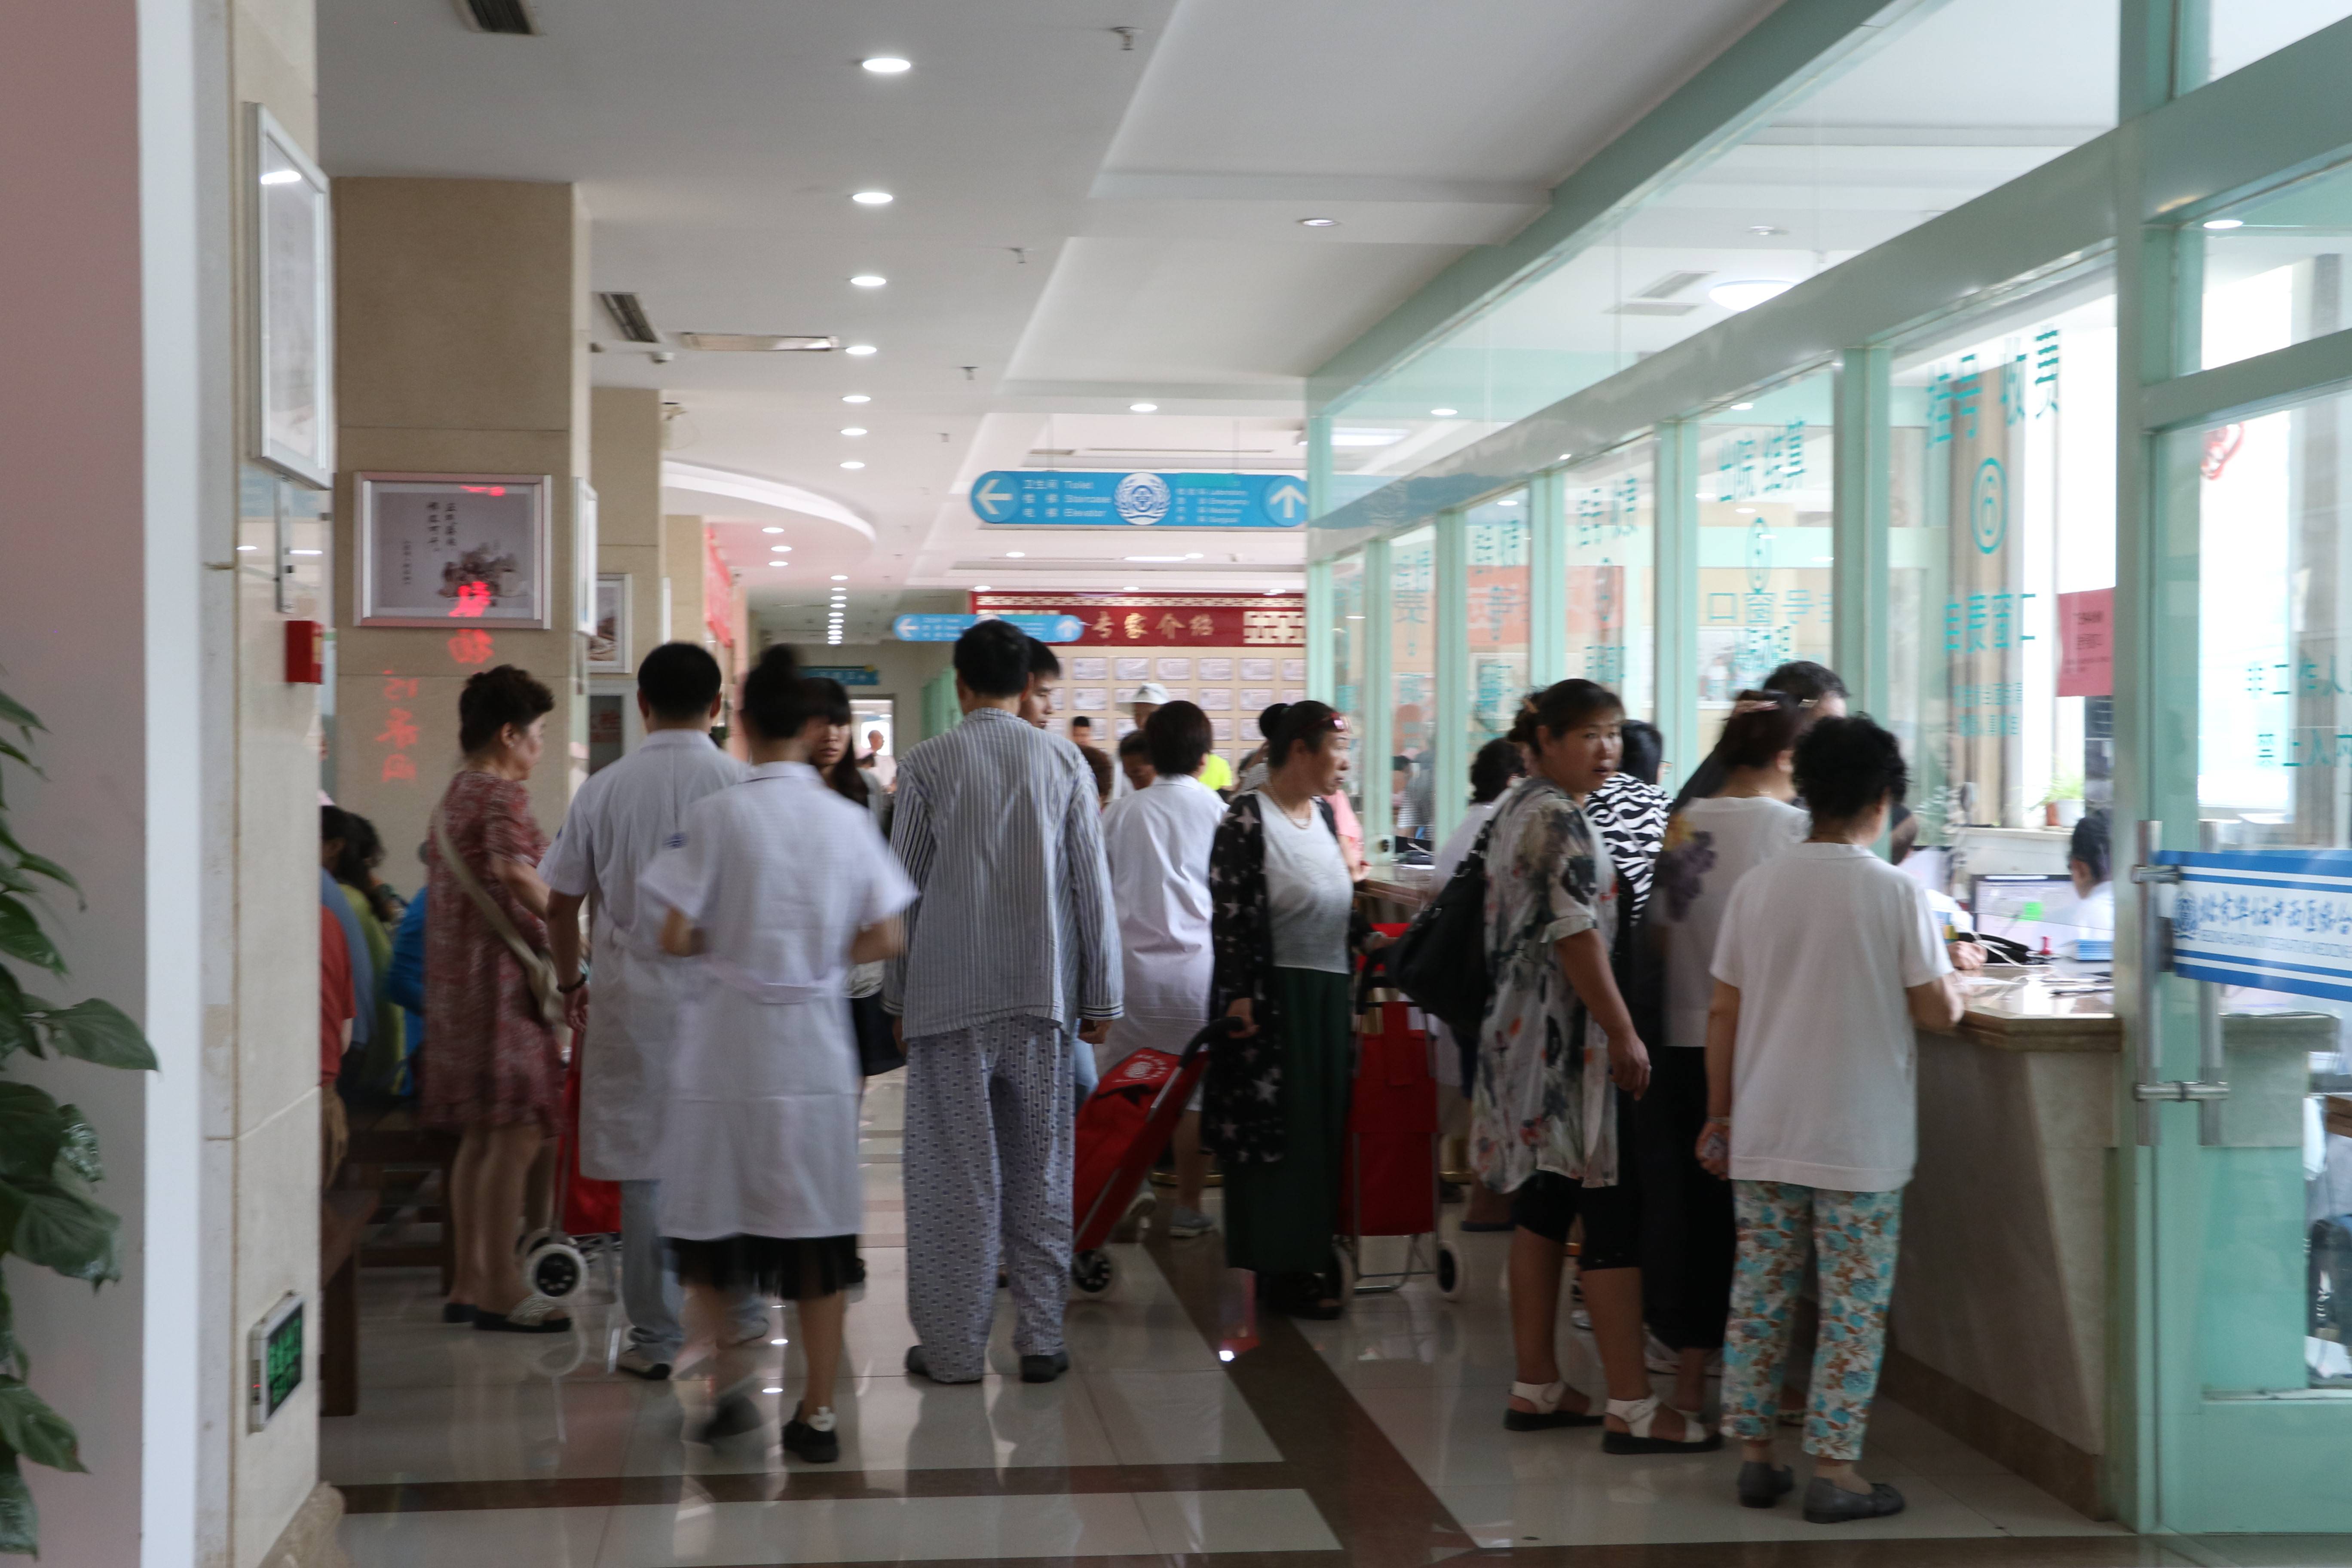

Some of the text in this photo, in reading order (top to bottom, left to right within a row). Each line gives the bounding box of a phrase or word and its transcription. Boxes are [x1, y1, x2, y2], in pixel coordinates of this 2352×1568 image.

[1063, 481, 1094, 489] Toilet
[1064, 494, 1112, 503] Staircase
[1064, 508, 1107, 517] Elevator
[1092, 611, 1215, 640] 专家介绍
[2245, 652, 2352, 698] 非工作人
